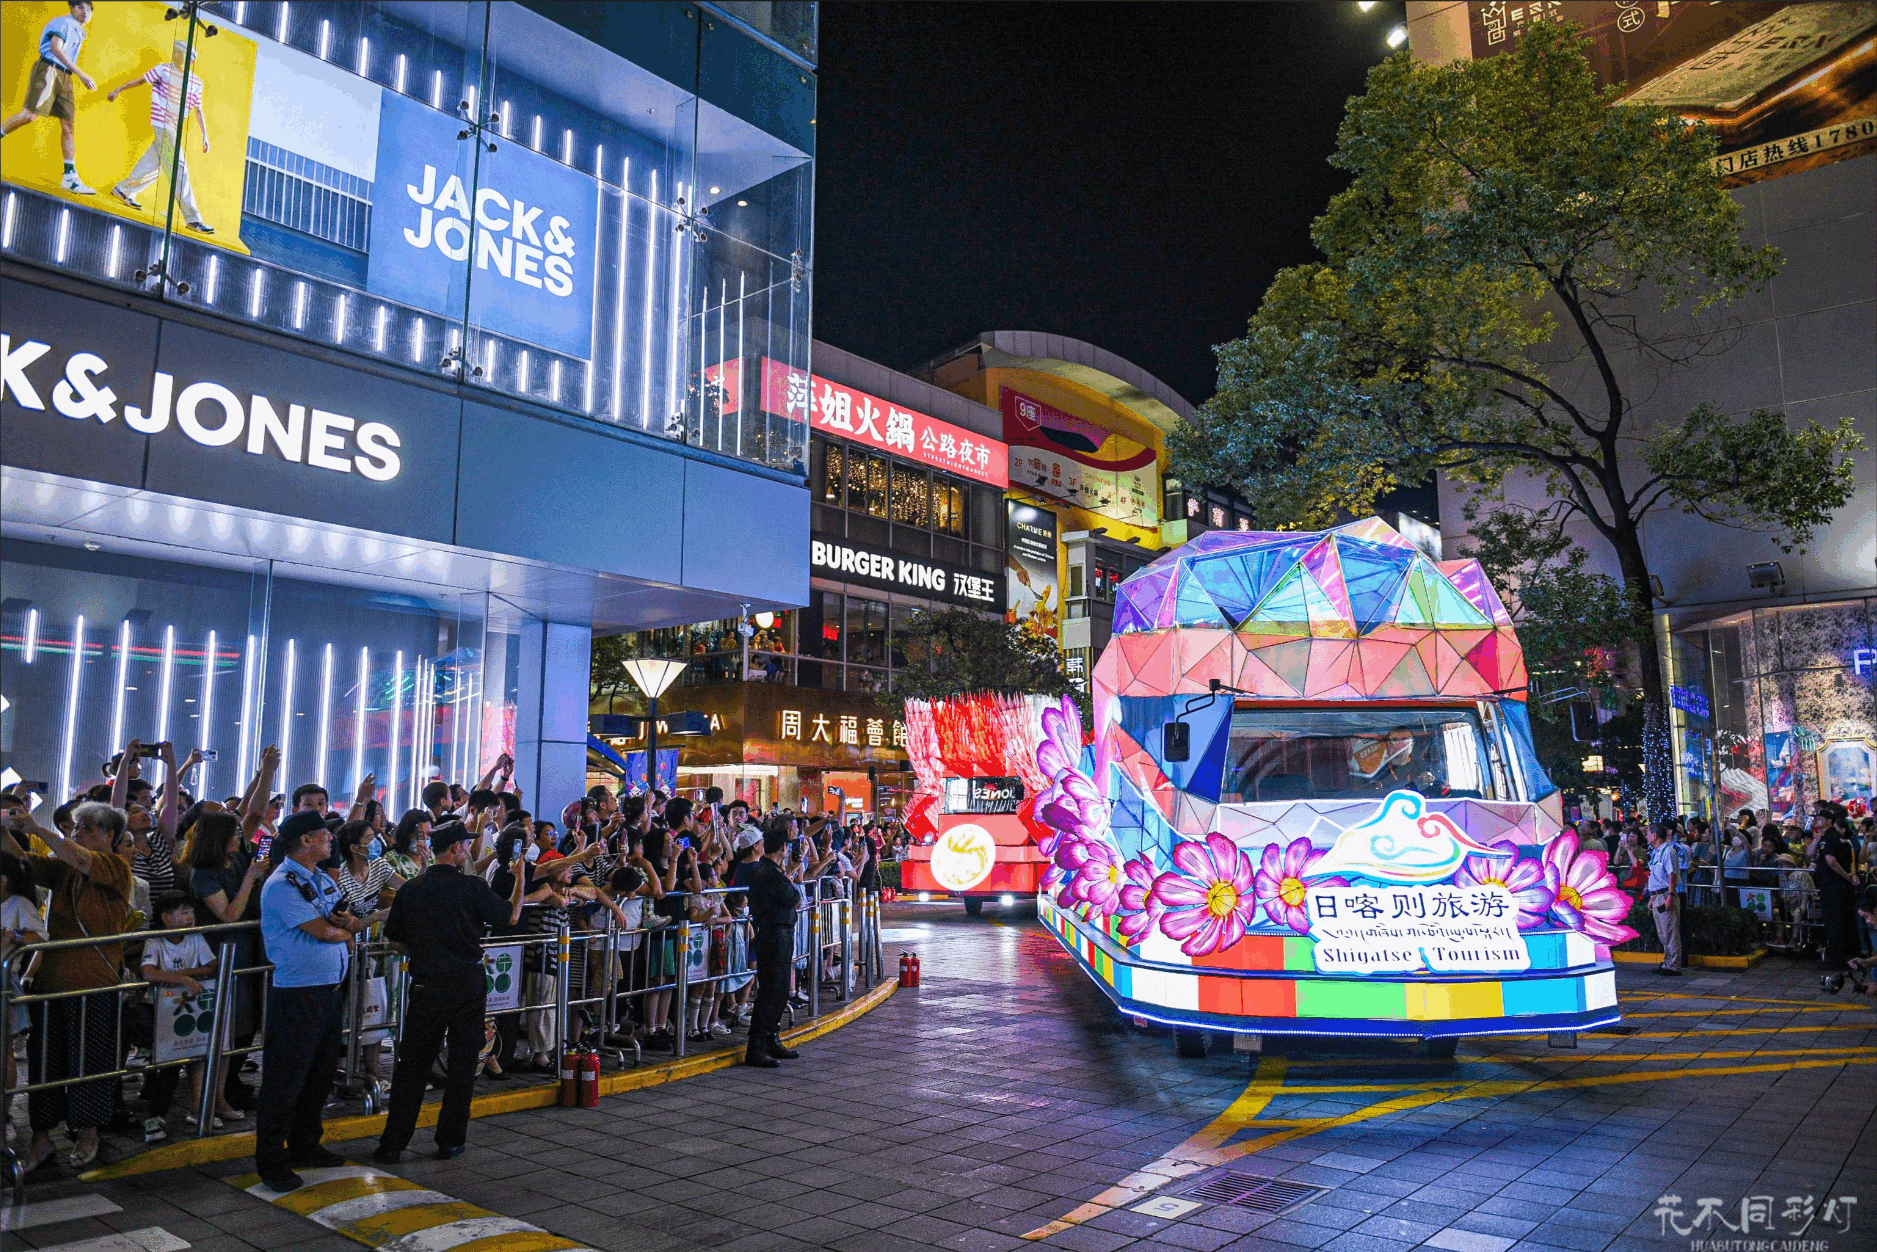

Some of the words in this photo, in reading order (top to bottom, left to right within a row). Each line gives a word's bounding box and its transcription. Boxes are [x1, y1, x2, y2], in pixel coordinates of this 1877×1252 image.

[403, 206, 574, 297] JONES
[1019, 402, 1036, 421] 9座
[919, 426, 991, 470] 公路夜市
[1014, 458, 1023, 467] 2F
[811, 540, 895, 581] BURGER
[898, 559, 946, 591] KING
[953, 572, 995, 602] 汉堡王
[1315, 891, 1510, 919] 日喀则旅游
[1322, 947, 1412, 965] Shigatse
[1432, 946, 1520, 962] Tourism
